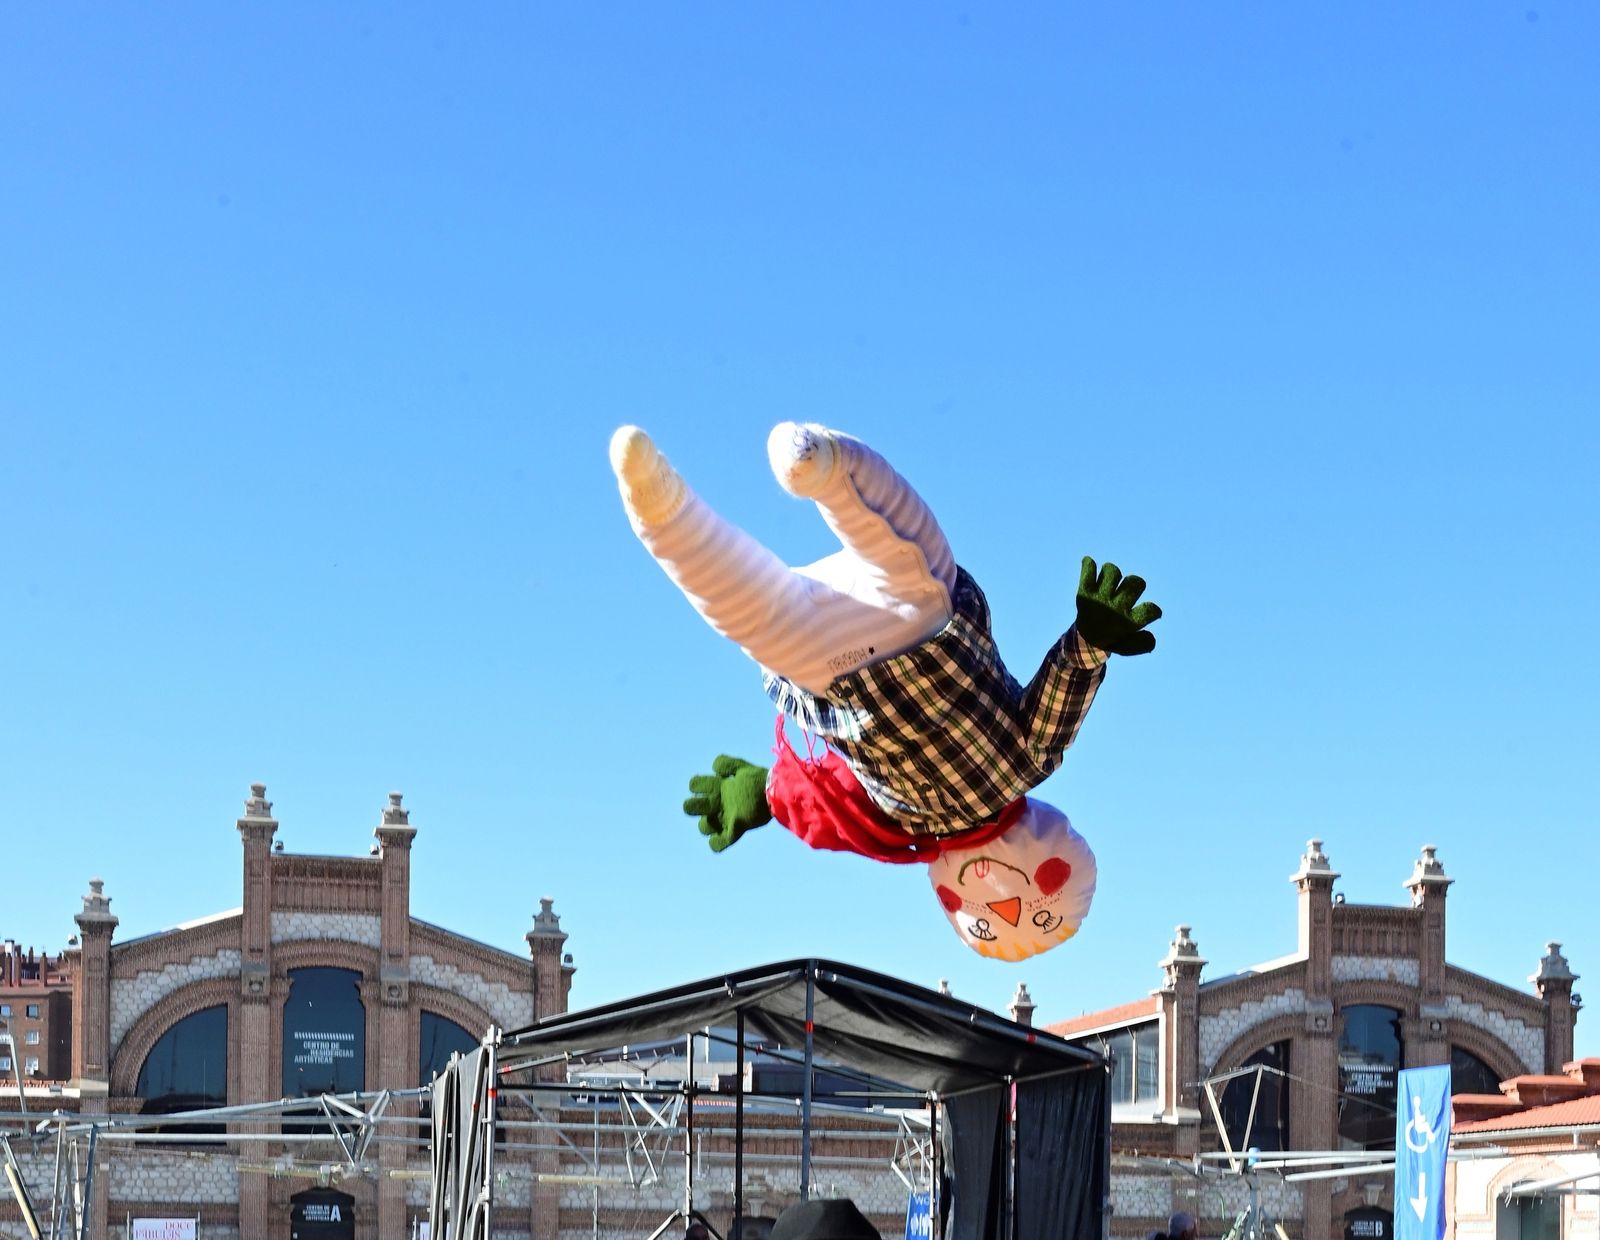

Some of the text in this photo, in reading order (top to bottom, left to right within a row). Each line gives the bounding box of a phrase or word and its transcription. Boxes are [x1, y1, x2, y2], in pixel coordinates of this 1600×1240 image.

[303, 1041, 340, 1050] CENTRO DE
[310, 1049, 354, 1058] RESIDENCIAS
[330, 1204, 342, 1222] A
[1375, 1220, 1384, 1238] B
